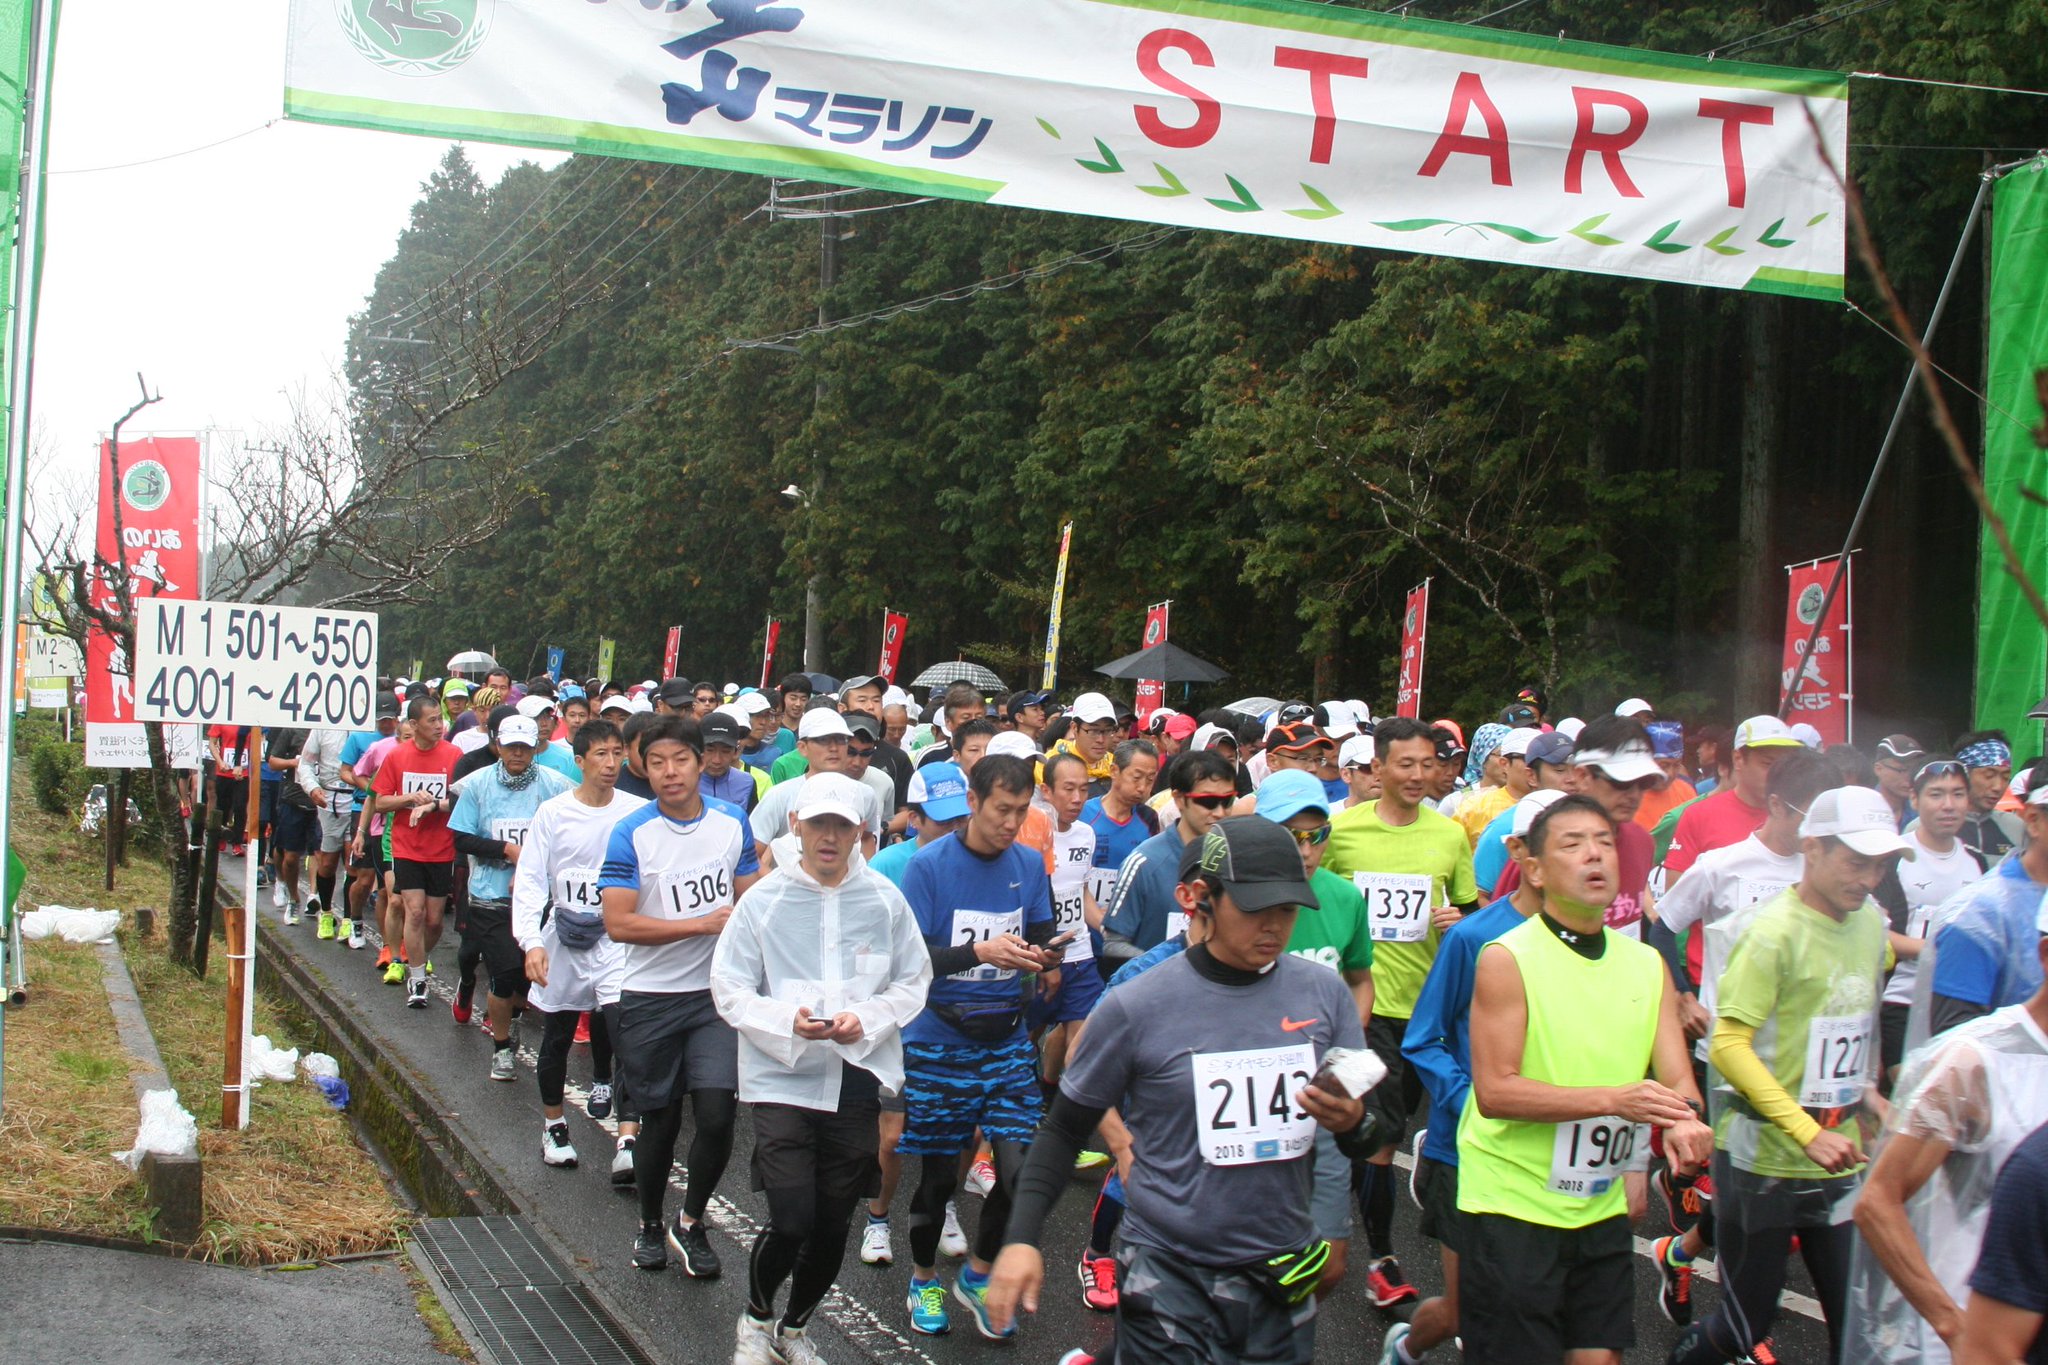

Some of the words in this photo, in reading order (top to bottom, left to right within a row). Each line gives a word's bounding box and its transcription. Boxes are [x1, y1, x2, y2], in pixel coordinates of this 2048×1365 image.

[774, 86, 993, 159] マラソン
[1134, 28, 1774, 209] START
[672, 868, 728, 912] 1306
[1364, 887, 1427, 920] 1337
[1208, 1070, 1309, 1130] 2143
[1215, 1144, 1245, 1159] 2018
[1558, 1180, 1583, 1192] 2018
